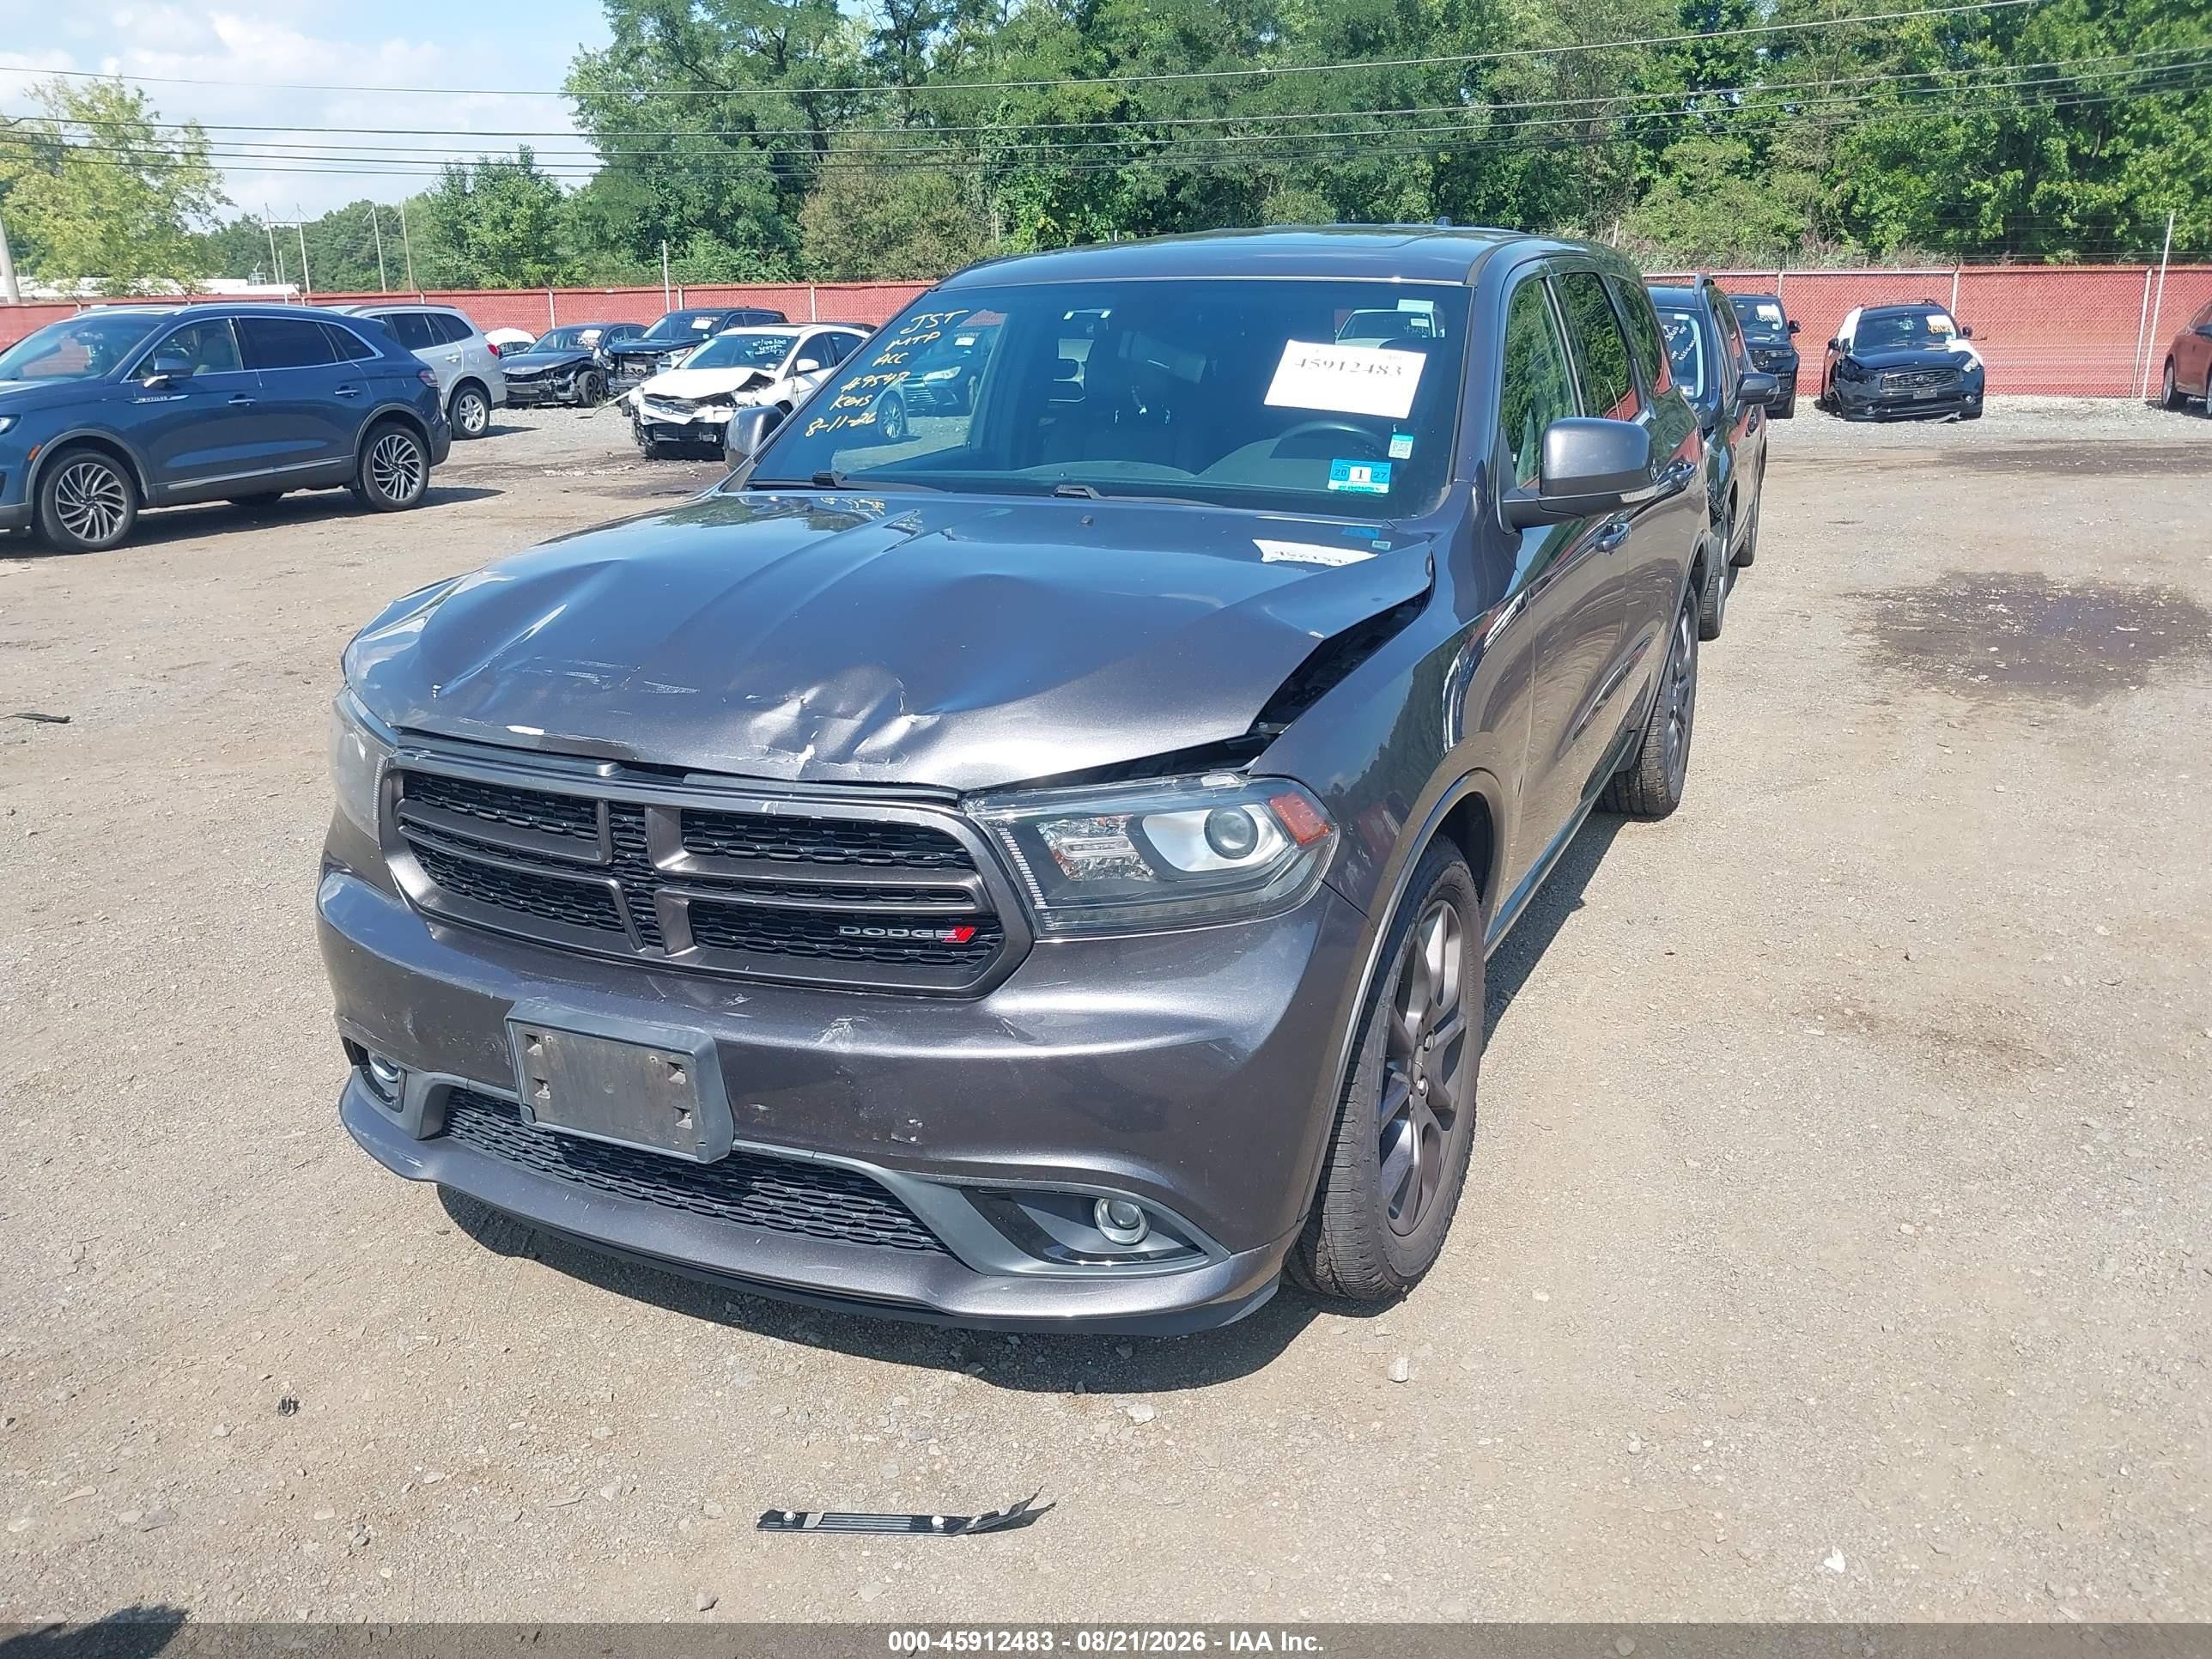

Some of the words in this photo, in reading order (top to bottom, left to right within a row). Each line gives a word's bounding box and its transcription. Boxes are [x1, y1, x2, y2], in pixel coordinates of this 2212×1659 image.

[899, 309, 970, 335] JST
[884, 331, 941, 351] MTP
[872, 352, 909, 368] ACC
[1293, 357, 1402, 377] 45912483
[805, 410, 878, 438] 8-11-26
[1334, 468, 1348, 477] 20
[1357, 468, 1364, 480] 1
[1372, 471, 1389, 480] 27
[838, 926, 957, 939] DODGE
